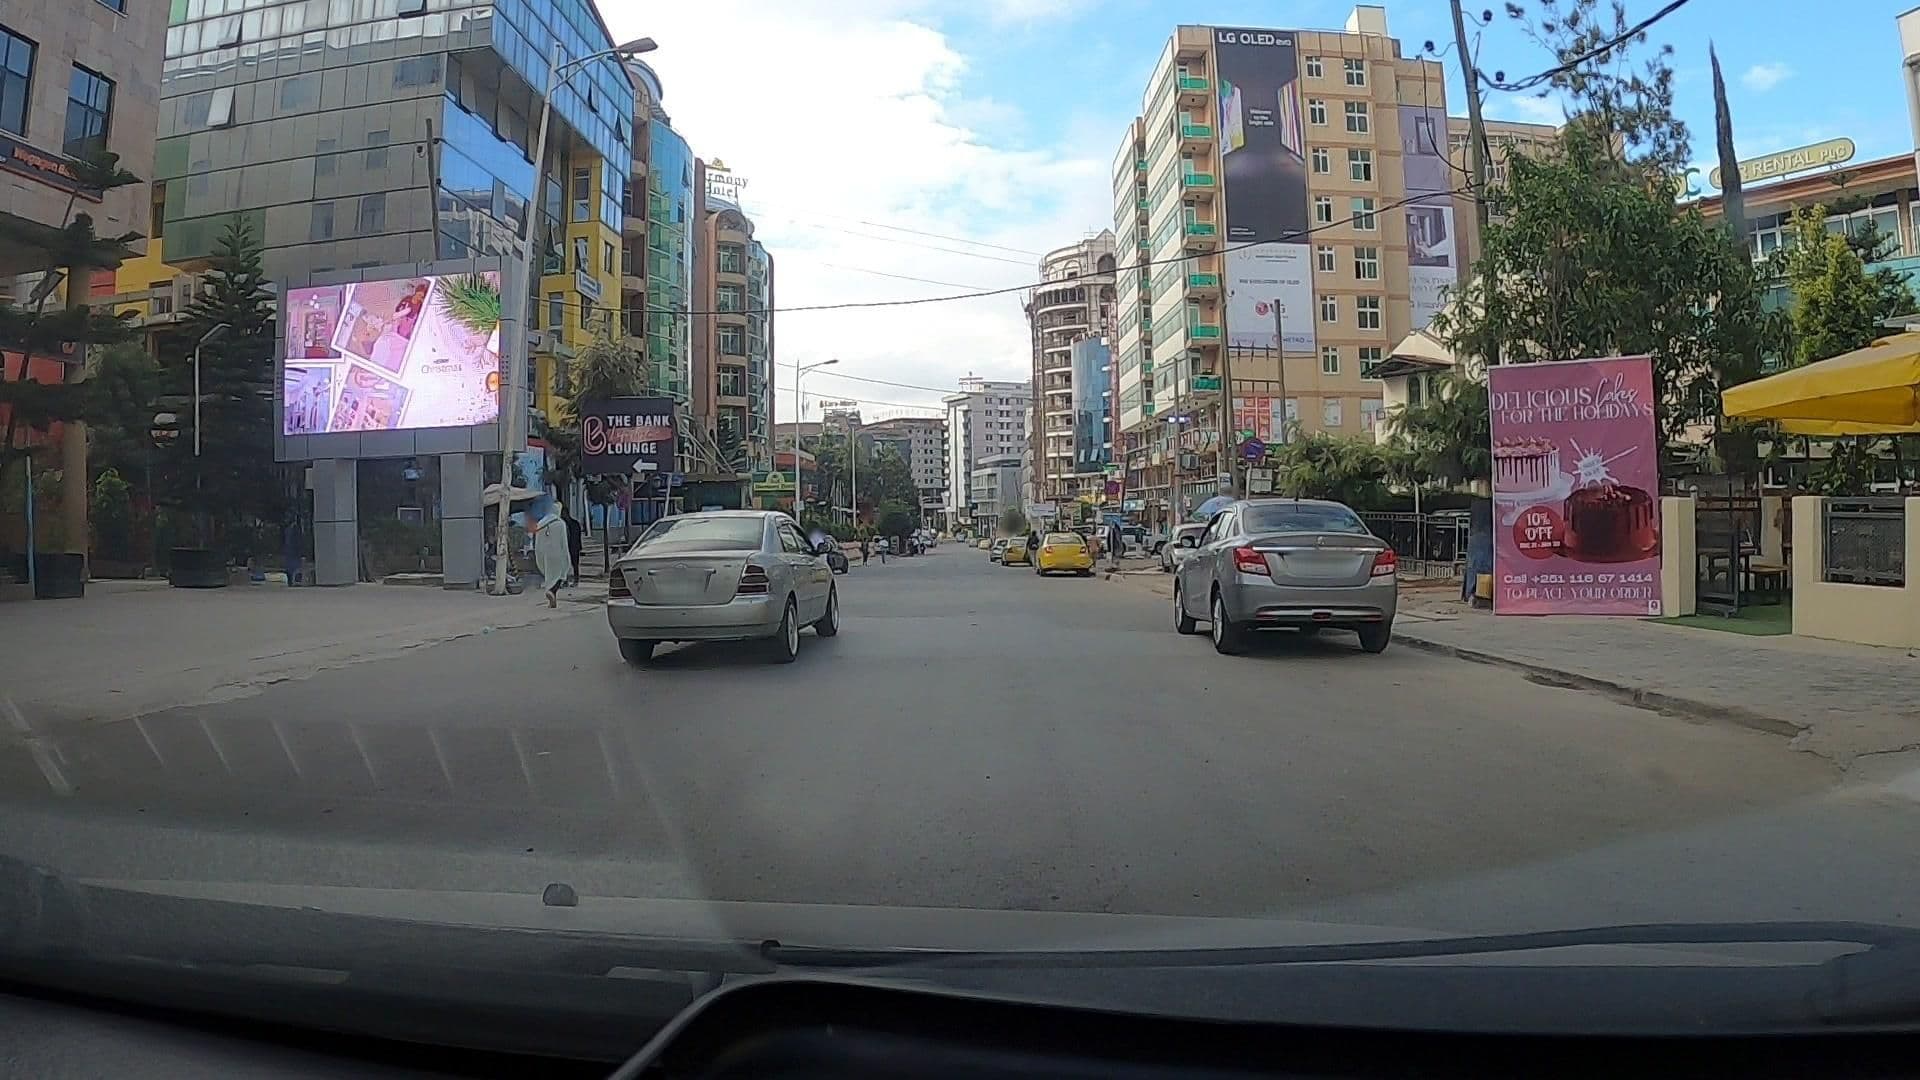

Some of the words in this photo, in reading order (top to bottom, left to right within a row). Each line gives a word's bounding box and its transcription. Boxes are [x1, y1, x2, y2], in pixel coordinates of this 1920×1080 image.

[1219, 31, 1236, 43] LG
[1240, 33, 1275, 45] OLED
[1752, 152, 1816, 176] RENTAL
[705, 173, 749, 189] rmony
[1492, 387, 1592, 410] DELICIOUS
[1501, 409, 1533, 424] FOR
[1541, 407, 1569, 421] THE
[1574, 402, 1654, 420] HOLIDAYS
[607, 415, 631, 427] THE
[635, 415, 671, 427] BANK
[607, 442, 657, 455] LOUNGE
[1526, 512, 1551, 526] 10%
[1525, 526, 1553, 541] OFF
[1504, 574, 1527, 584] Call
[1531, 574, 1565, 584] +251
[1569, 574, 1593, 583] 116
[1619, 573, 1652, 583] 1414
[1503, 587, 1522, 599] TO
[1526, 587, 1566, 599] PLACE
[1570, 587, 1606, 599] YOUR
[1610, 586, 1652, 599] ORDER
